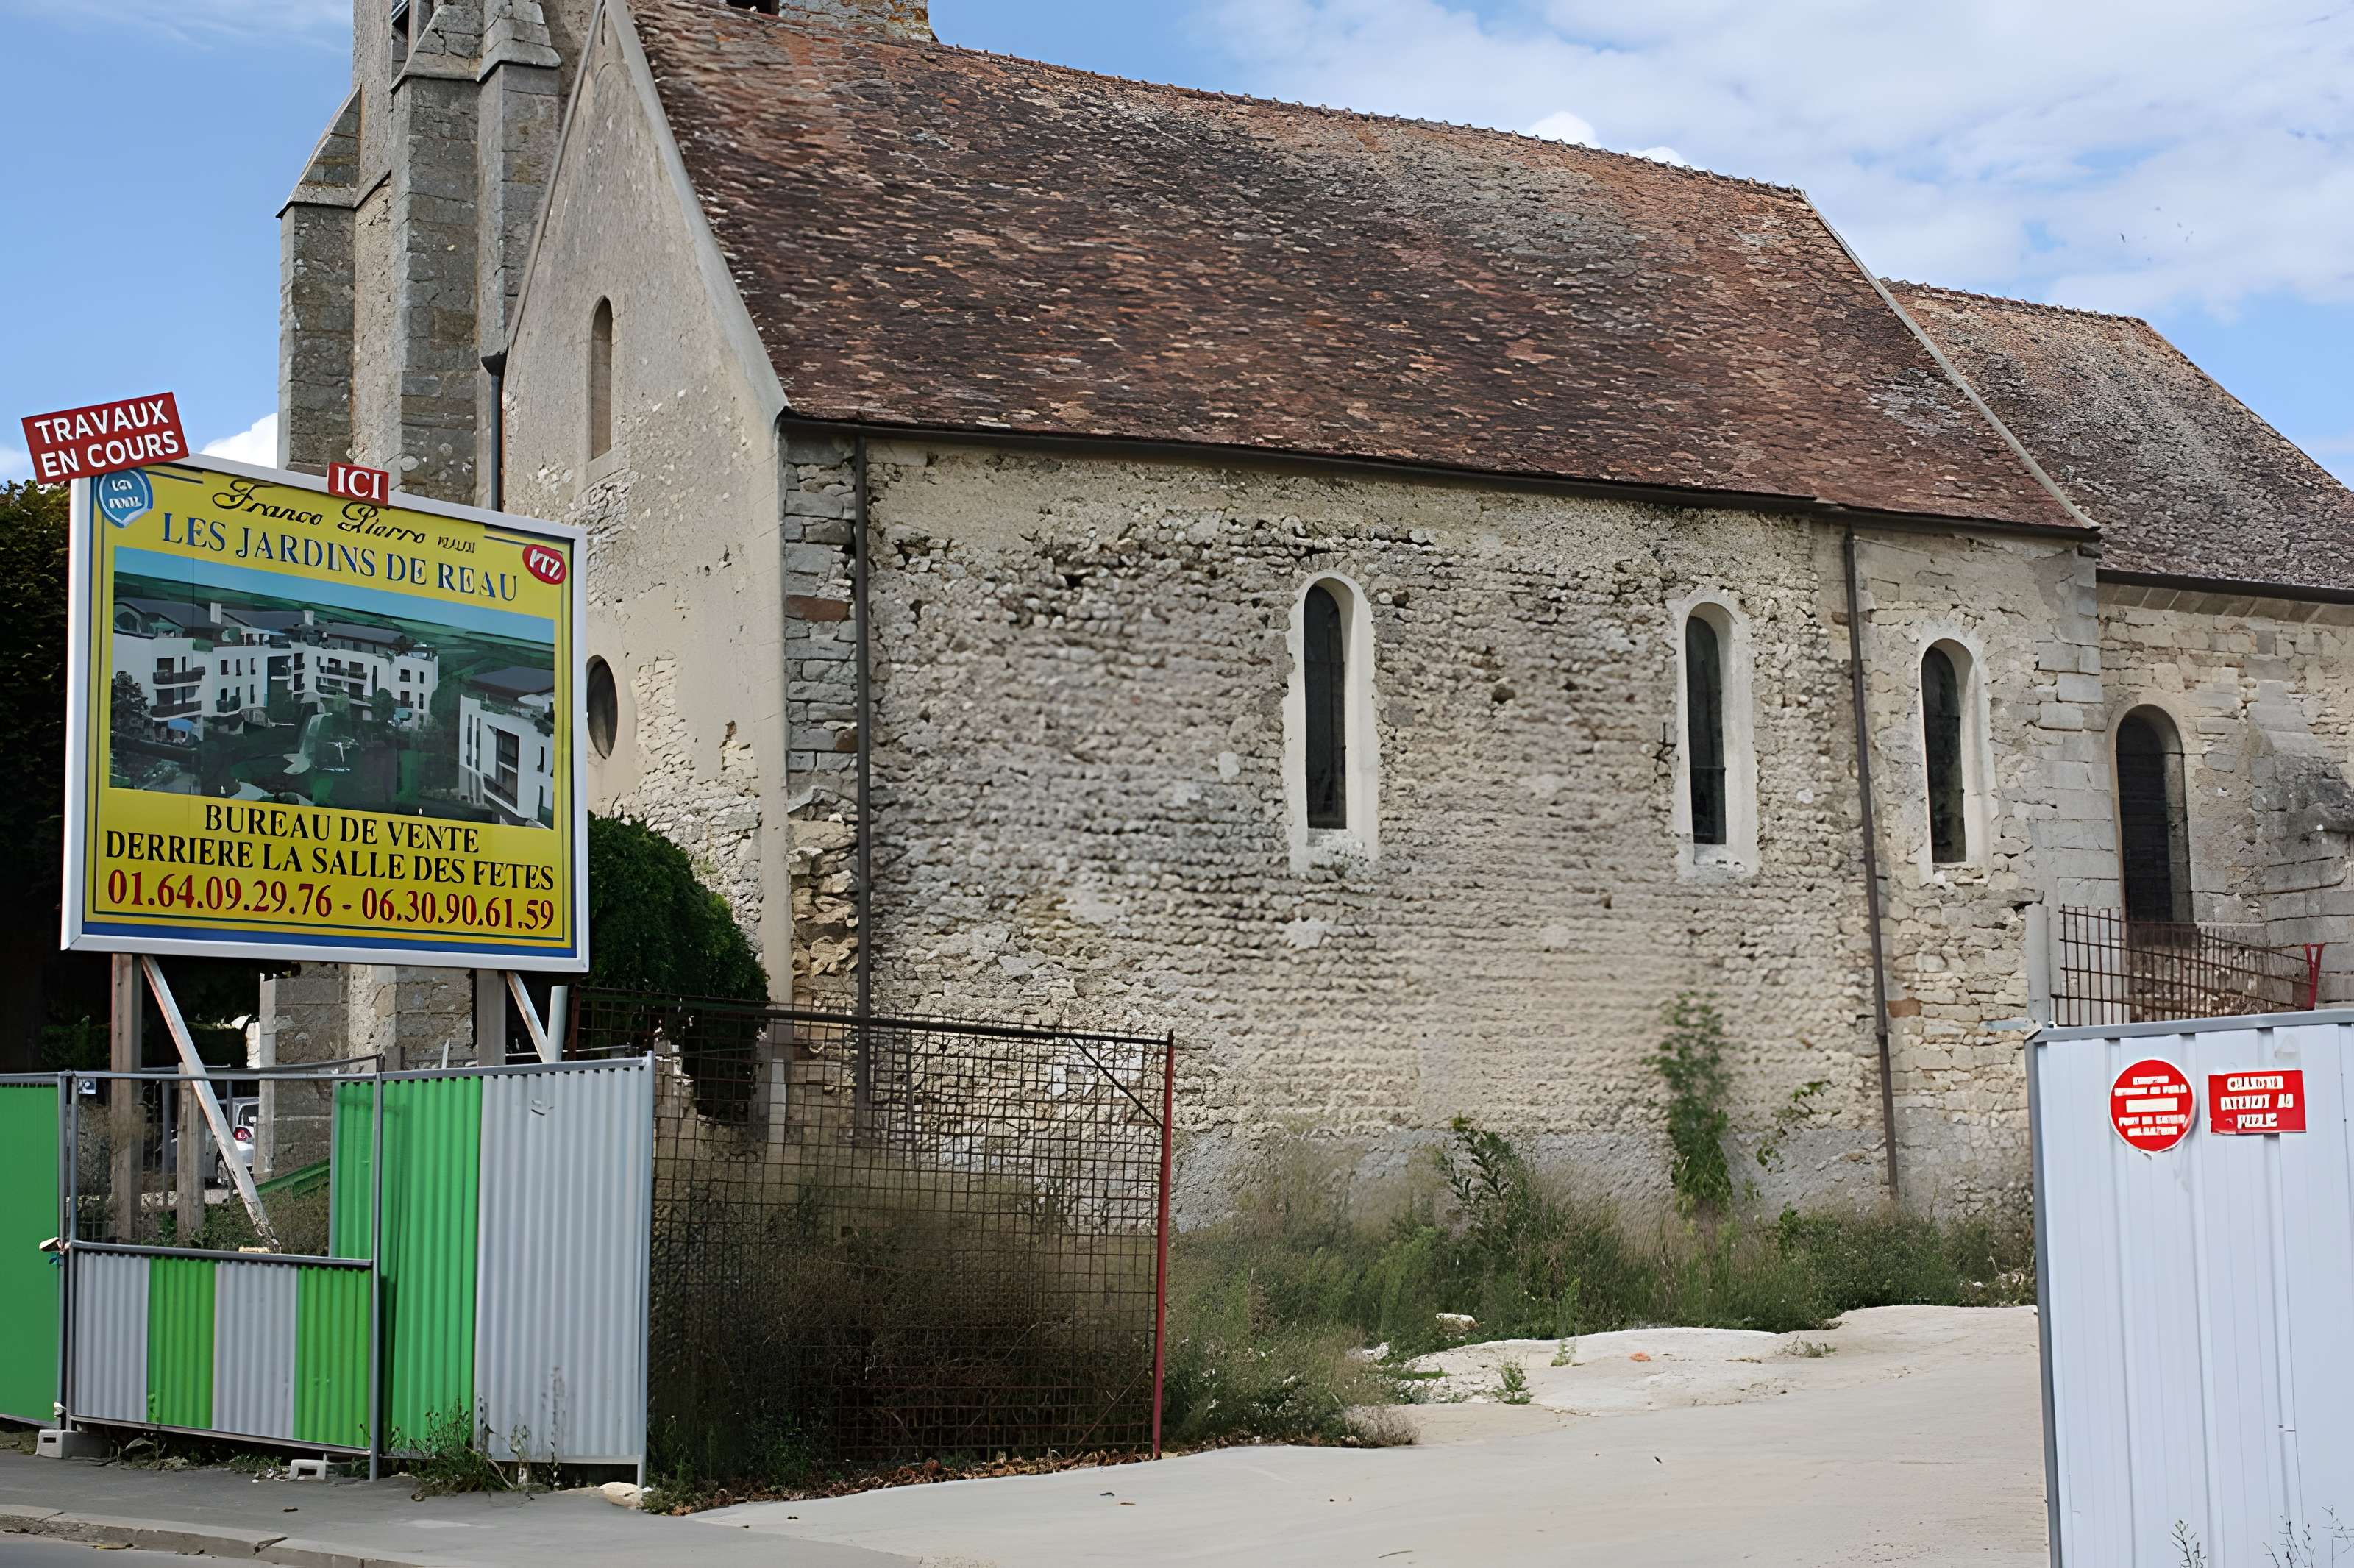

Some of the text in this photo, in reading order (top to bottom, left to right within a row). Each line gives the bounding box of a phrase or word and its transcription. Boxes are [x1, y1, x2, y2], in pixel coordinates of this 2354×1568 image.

[35, 400, 168, 444] TRAVAUX
[40, 430, 179, 477] EN COURS
[337, 466, 382, 499] ICI
[162, 513, 517, 601] LES JARDINS DE REAU
[205, 804, 479, 853] BUREAU DE VENTE
[106, 830, 554, 891] DERRIERE LA SALLE DES FETES
[108, 869, 332, 918] 01.64.09.29.76
[362, 887, 554, 930] 06.30.90.61.59
